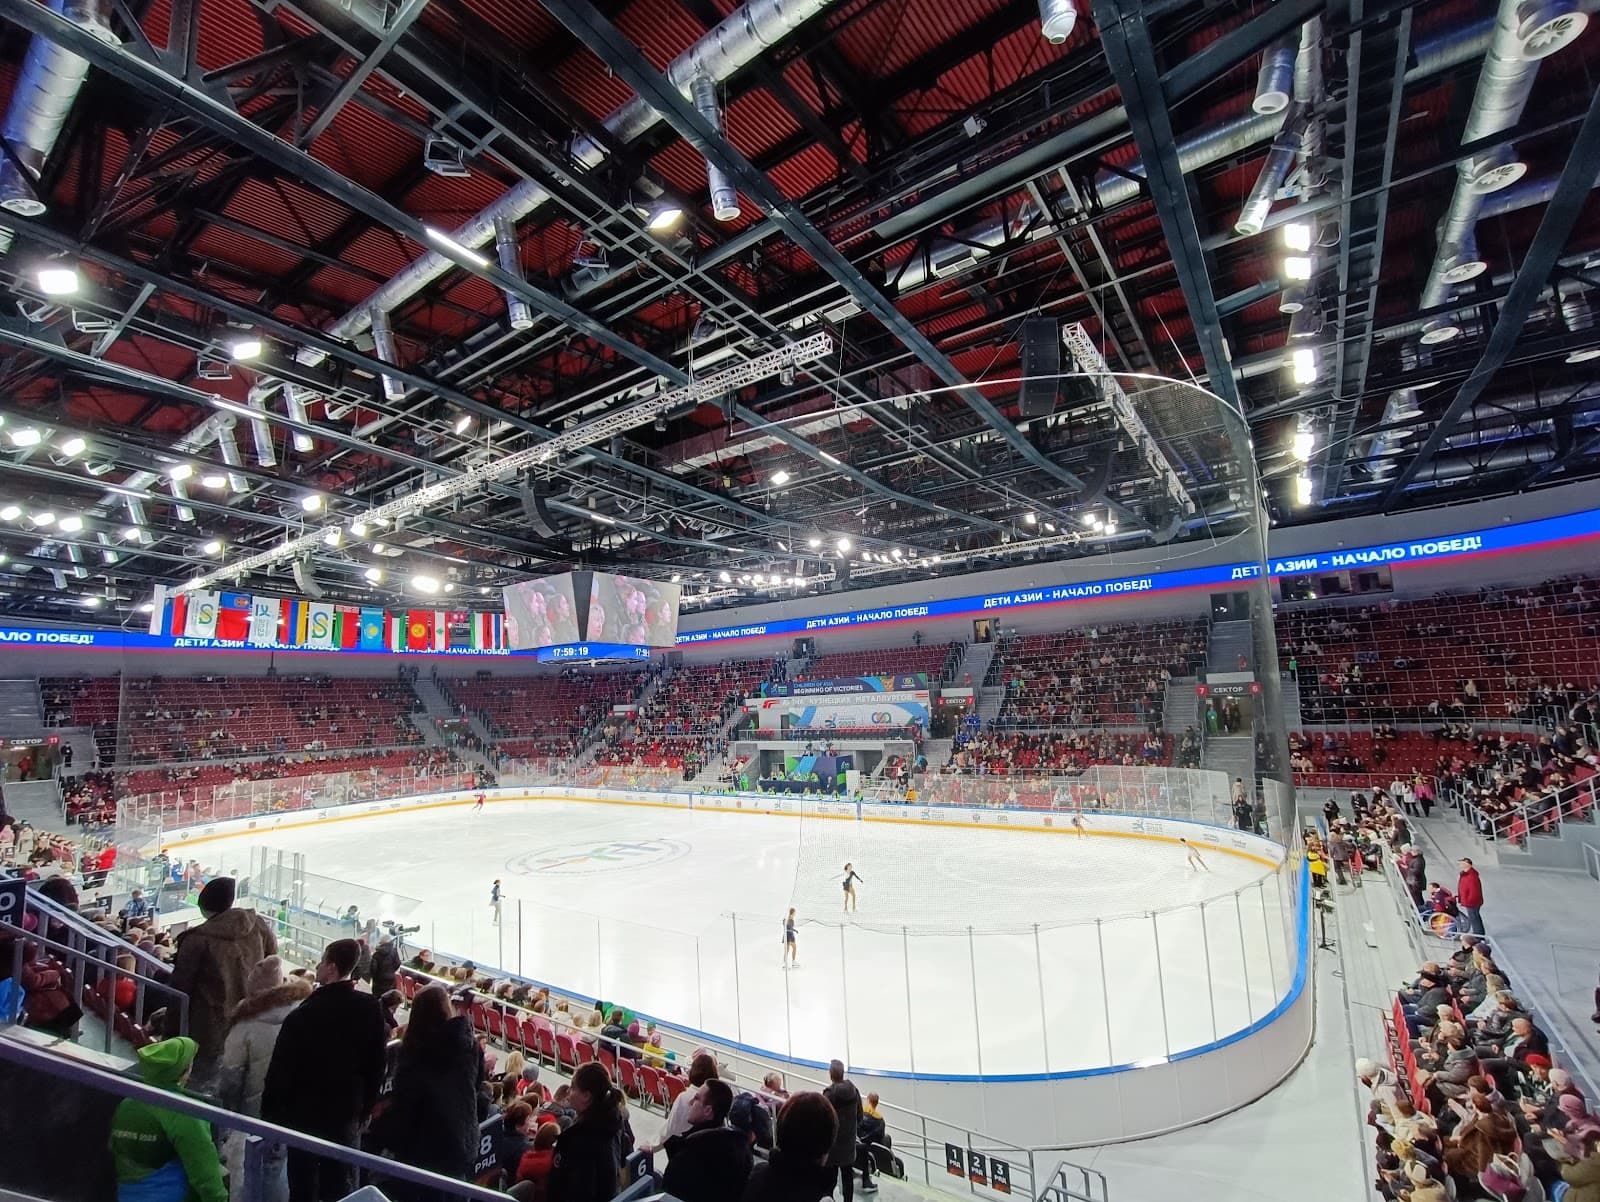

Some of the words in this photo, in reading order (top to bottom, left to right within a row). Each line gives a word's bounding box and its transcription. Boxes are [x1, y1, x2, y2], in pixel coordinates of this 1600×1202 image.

[1274, 559, 1318, 573] АЗИИ
[1332, 548, 1406, 566] НАЧАЛО
[1410, 536, 1482, 556] ПОБЕД!
[984, 597, 1011, 608] ДЕТИ
[1014, 592, 1043, 603] АЗИИ
[1052, 585, 1102, 599] НАЧАЛО
[1105, 579, 1152, 592] ПОБЕД!
[806, 619, 827, 629] ДЕТИ
[828, 617, 850, 625] АЗИИ
[857, 611, 892, 622] НАЧАЛО
[895, 607, 929, 617] ПОБЕД!
[36, 633, 94, 644] ПОБЕД!
[691, 633, 708, 641] АЗИИ
[713, 630, 740, 639] НАЧАЛО
[741, 626, 766, 635] ПОБЕД!
[174, 638, 208, 648] ДЕТИ
[211, 640, 246, 648] АЗИИ
[480, 1135, 493, 1155] 8
[951, 1148, 958, 1160] 1
[972, 1156, 981, 1168] 2
[474, 1153, 497, 1174] РЯД
[637, 1159, 647, 1177] 6
[996, 1163, 1004, 1175] 3
